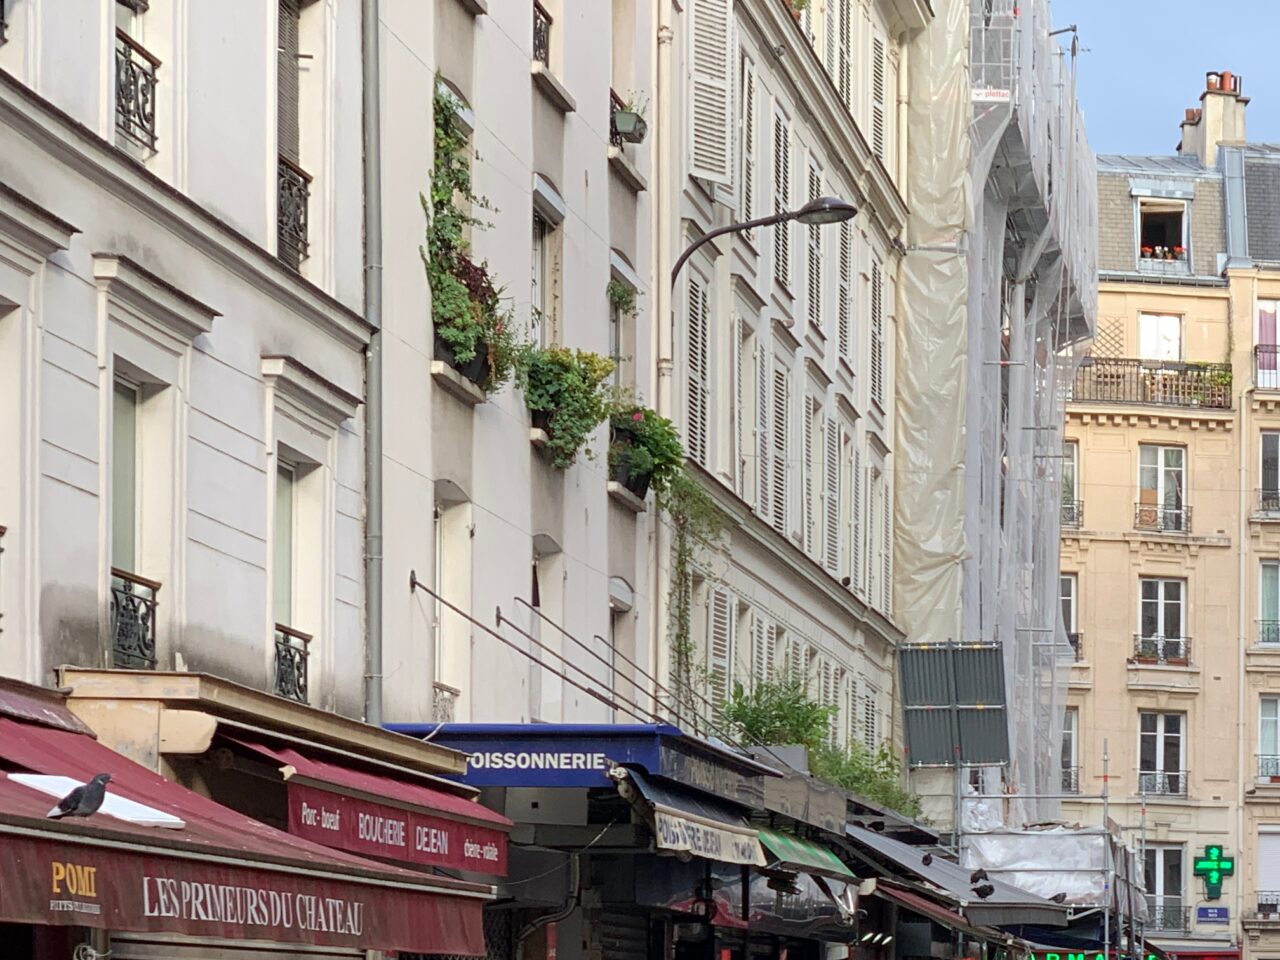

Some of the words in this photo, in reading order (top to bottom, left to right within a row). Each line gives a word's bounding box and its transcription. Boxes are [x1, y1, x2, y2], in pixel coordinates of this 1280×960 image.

[358, 812, 405, 846] BOUCHERIE
[416, 826, 448, 854] DEJEAN
[52, 861, 97, 898] POMI
[143, 877, 180, 917] LES
[181, 882, 269, 926] PRIMEURS
[270, 891, 292, 928] DU
[295, 894, 364, 936] CHATEAU
